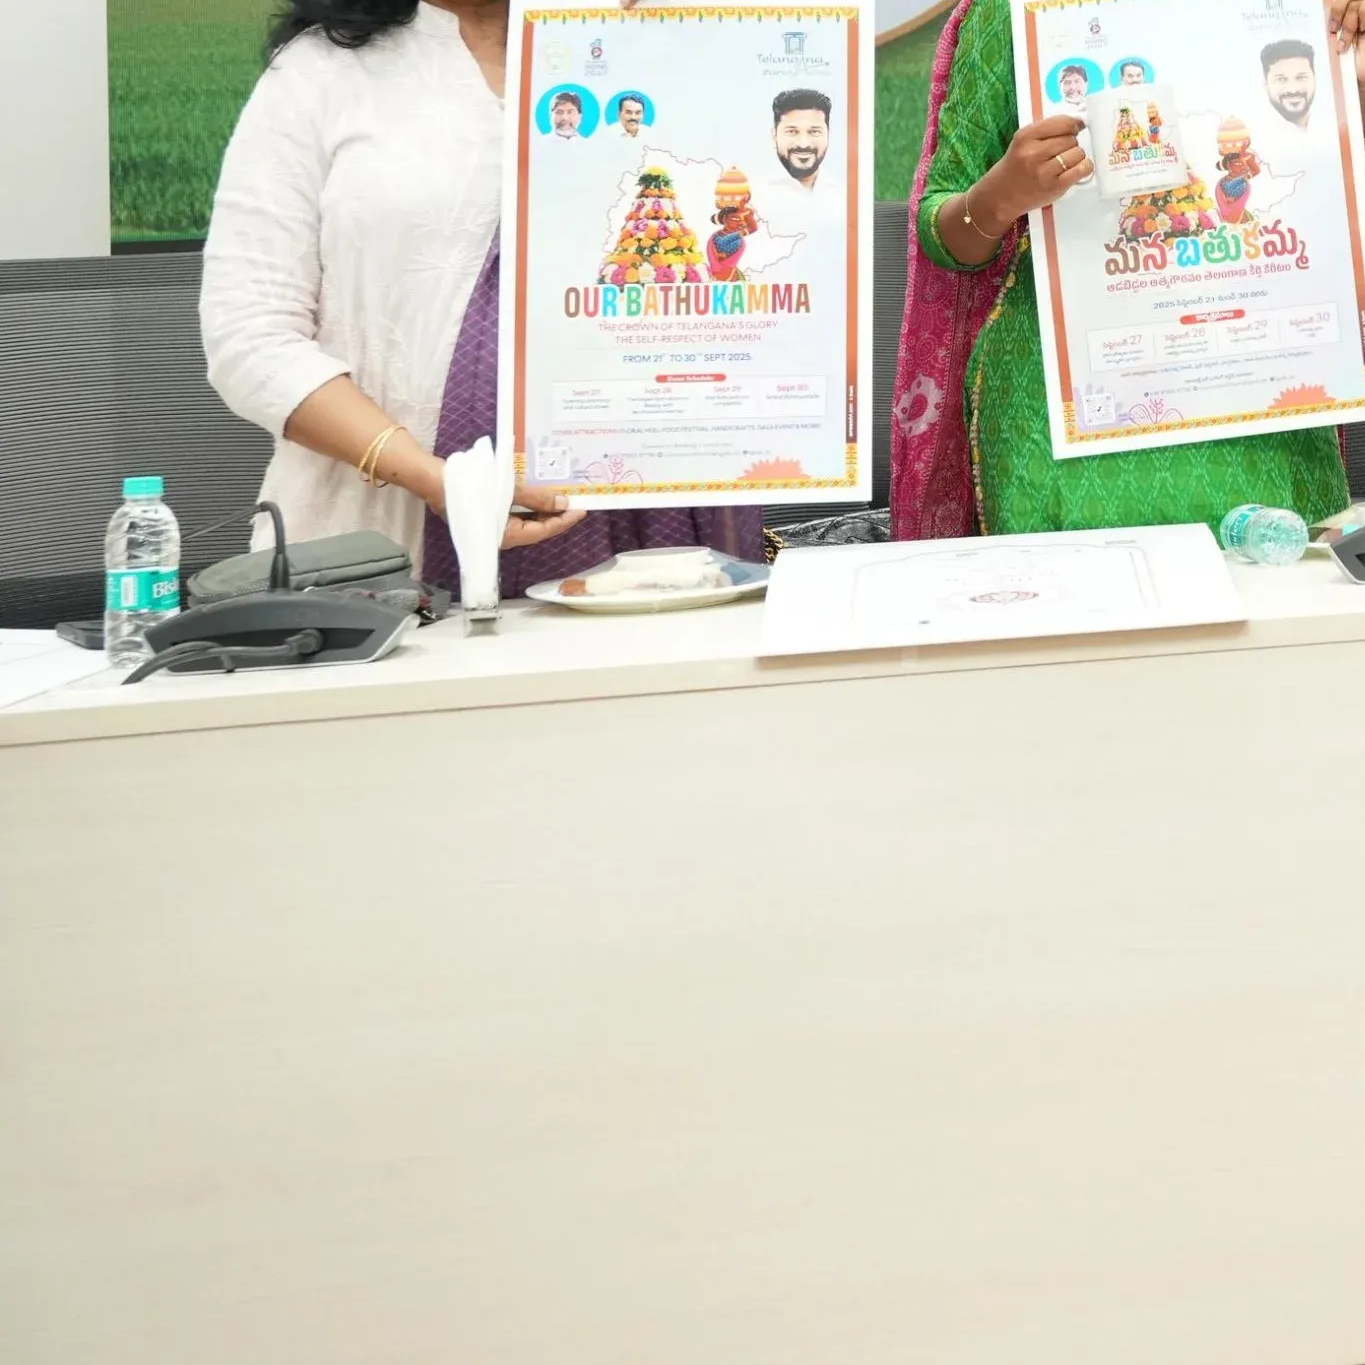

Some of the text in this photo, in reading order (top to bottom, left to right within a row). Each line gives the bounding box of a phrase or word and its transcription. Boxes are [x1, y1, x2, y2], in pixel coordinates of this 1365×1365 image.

[1104, 219, 1310, 276] మన బతుకమ్మ
[564, 283, 811, 318] OUR BATHUKAMMA
[1315, 312, 1330, 323] 30
[598, 322, 617, 332] THE
[617, 321, 658, 332] CROWN
[660, 321, 674, 331] OF
[745, 320, 779, 330] GLORY
[1253, 320, 1268, 331] 29
[1191, 327, 1206, 338] 28
[615, 333, 762, 345] THE SELF-RESPECT OF WOMEN
[1129, 334, 1143, 345] 27
[622, 354, 652, 364] FROM
[670, 353, 684, 362] TO
[704, 352, 726, 362] SEPT
